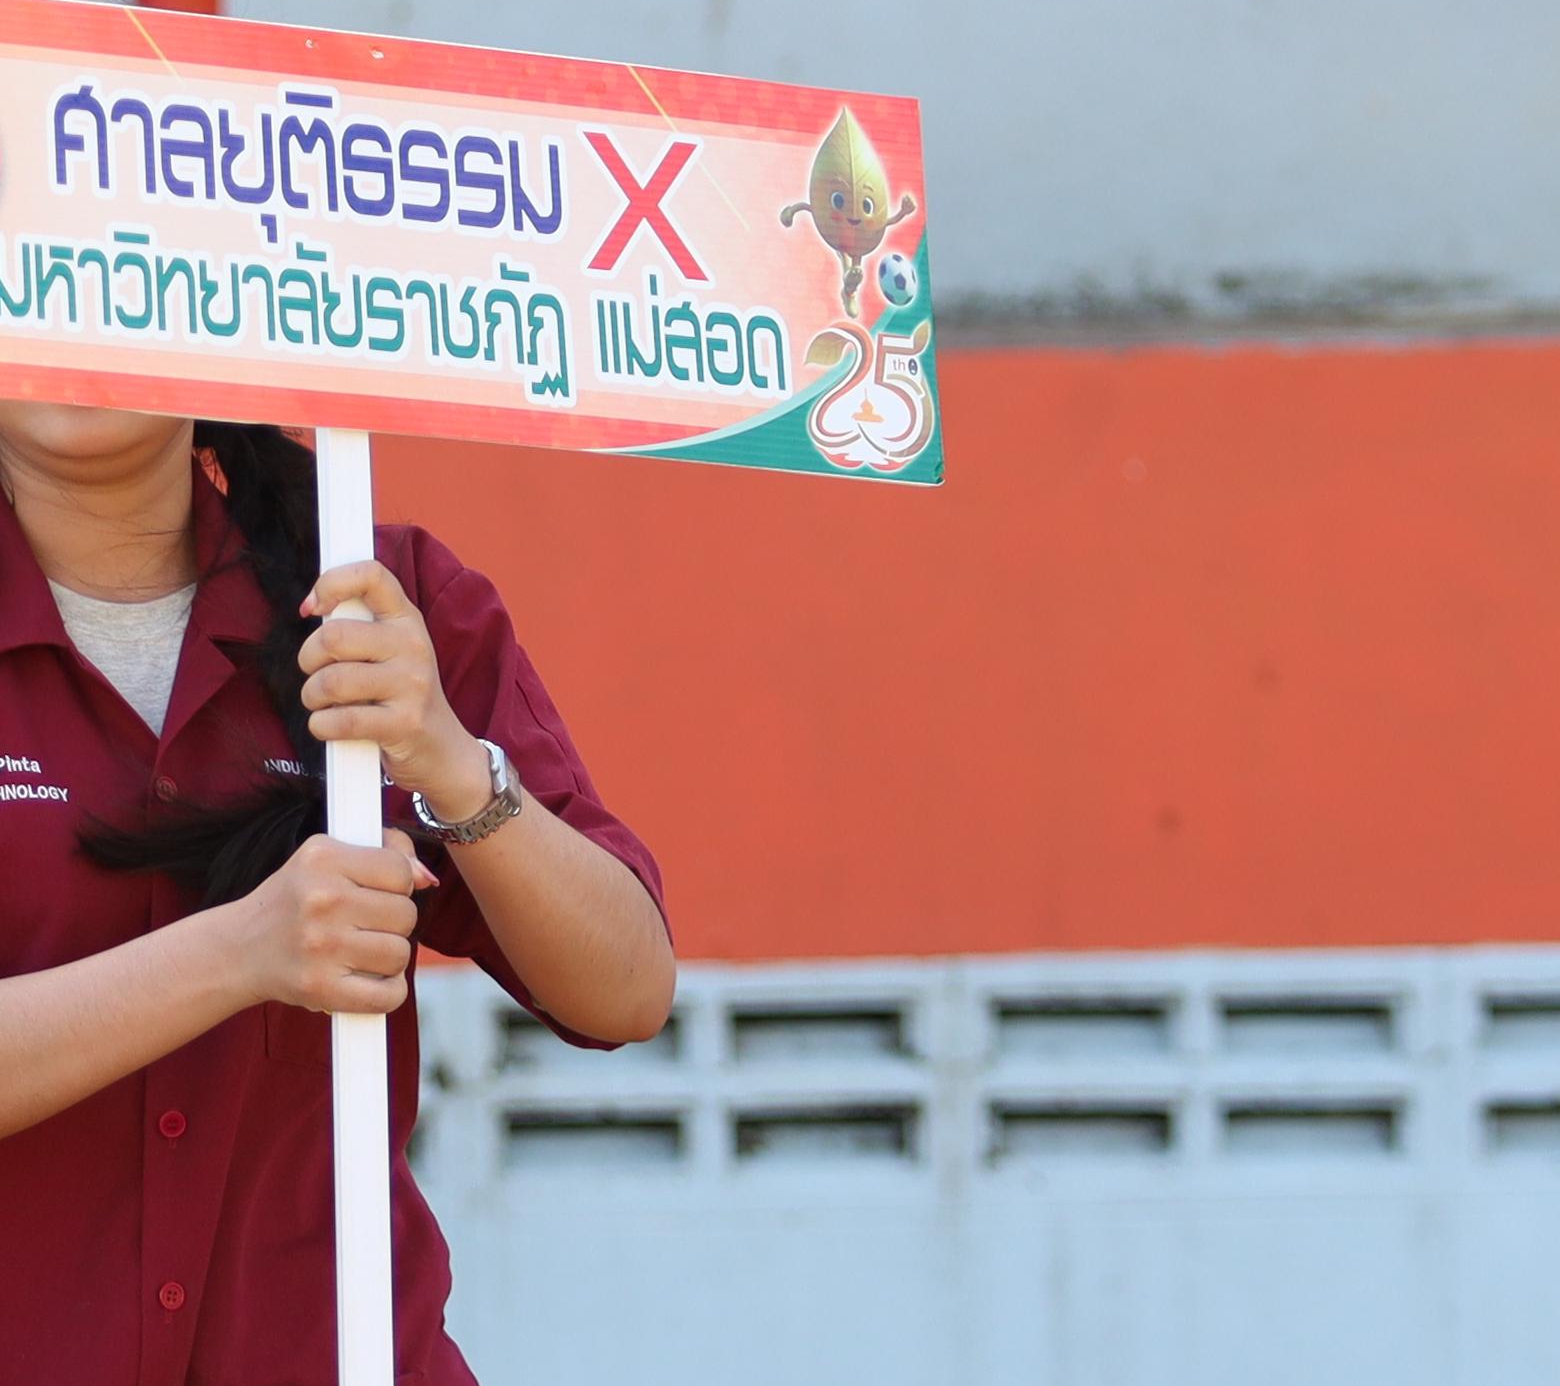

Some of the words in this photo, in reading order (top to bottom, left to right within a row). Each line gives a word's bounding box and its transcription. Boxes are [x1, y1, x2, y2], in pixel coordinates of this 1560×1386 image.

[53, 85, 563, 244] ศาลยุติธรรม
[582, 130, 710, 282] X
[595, 273, 787, 391] แม่สอด
